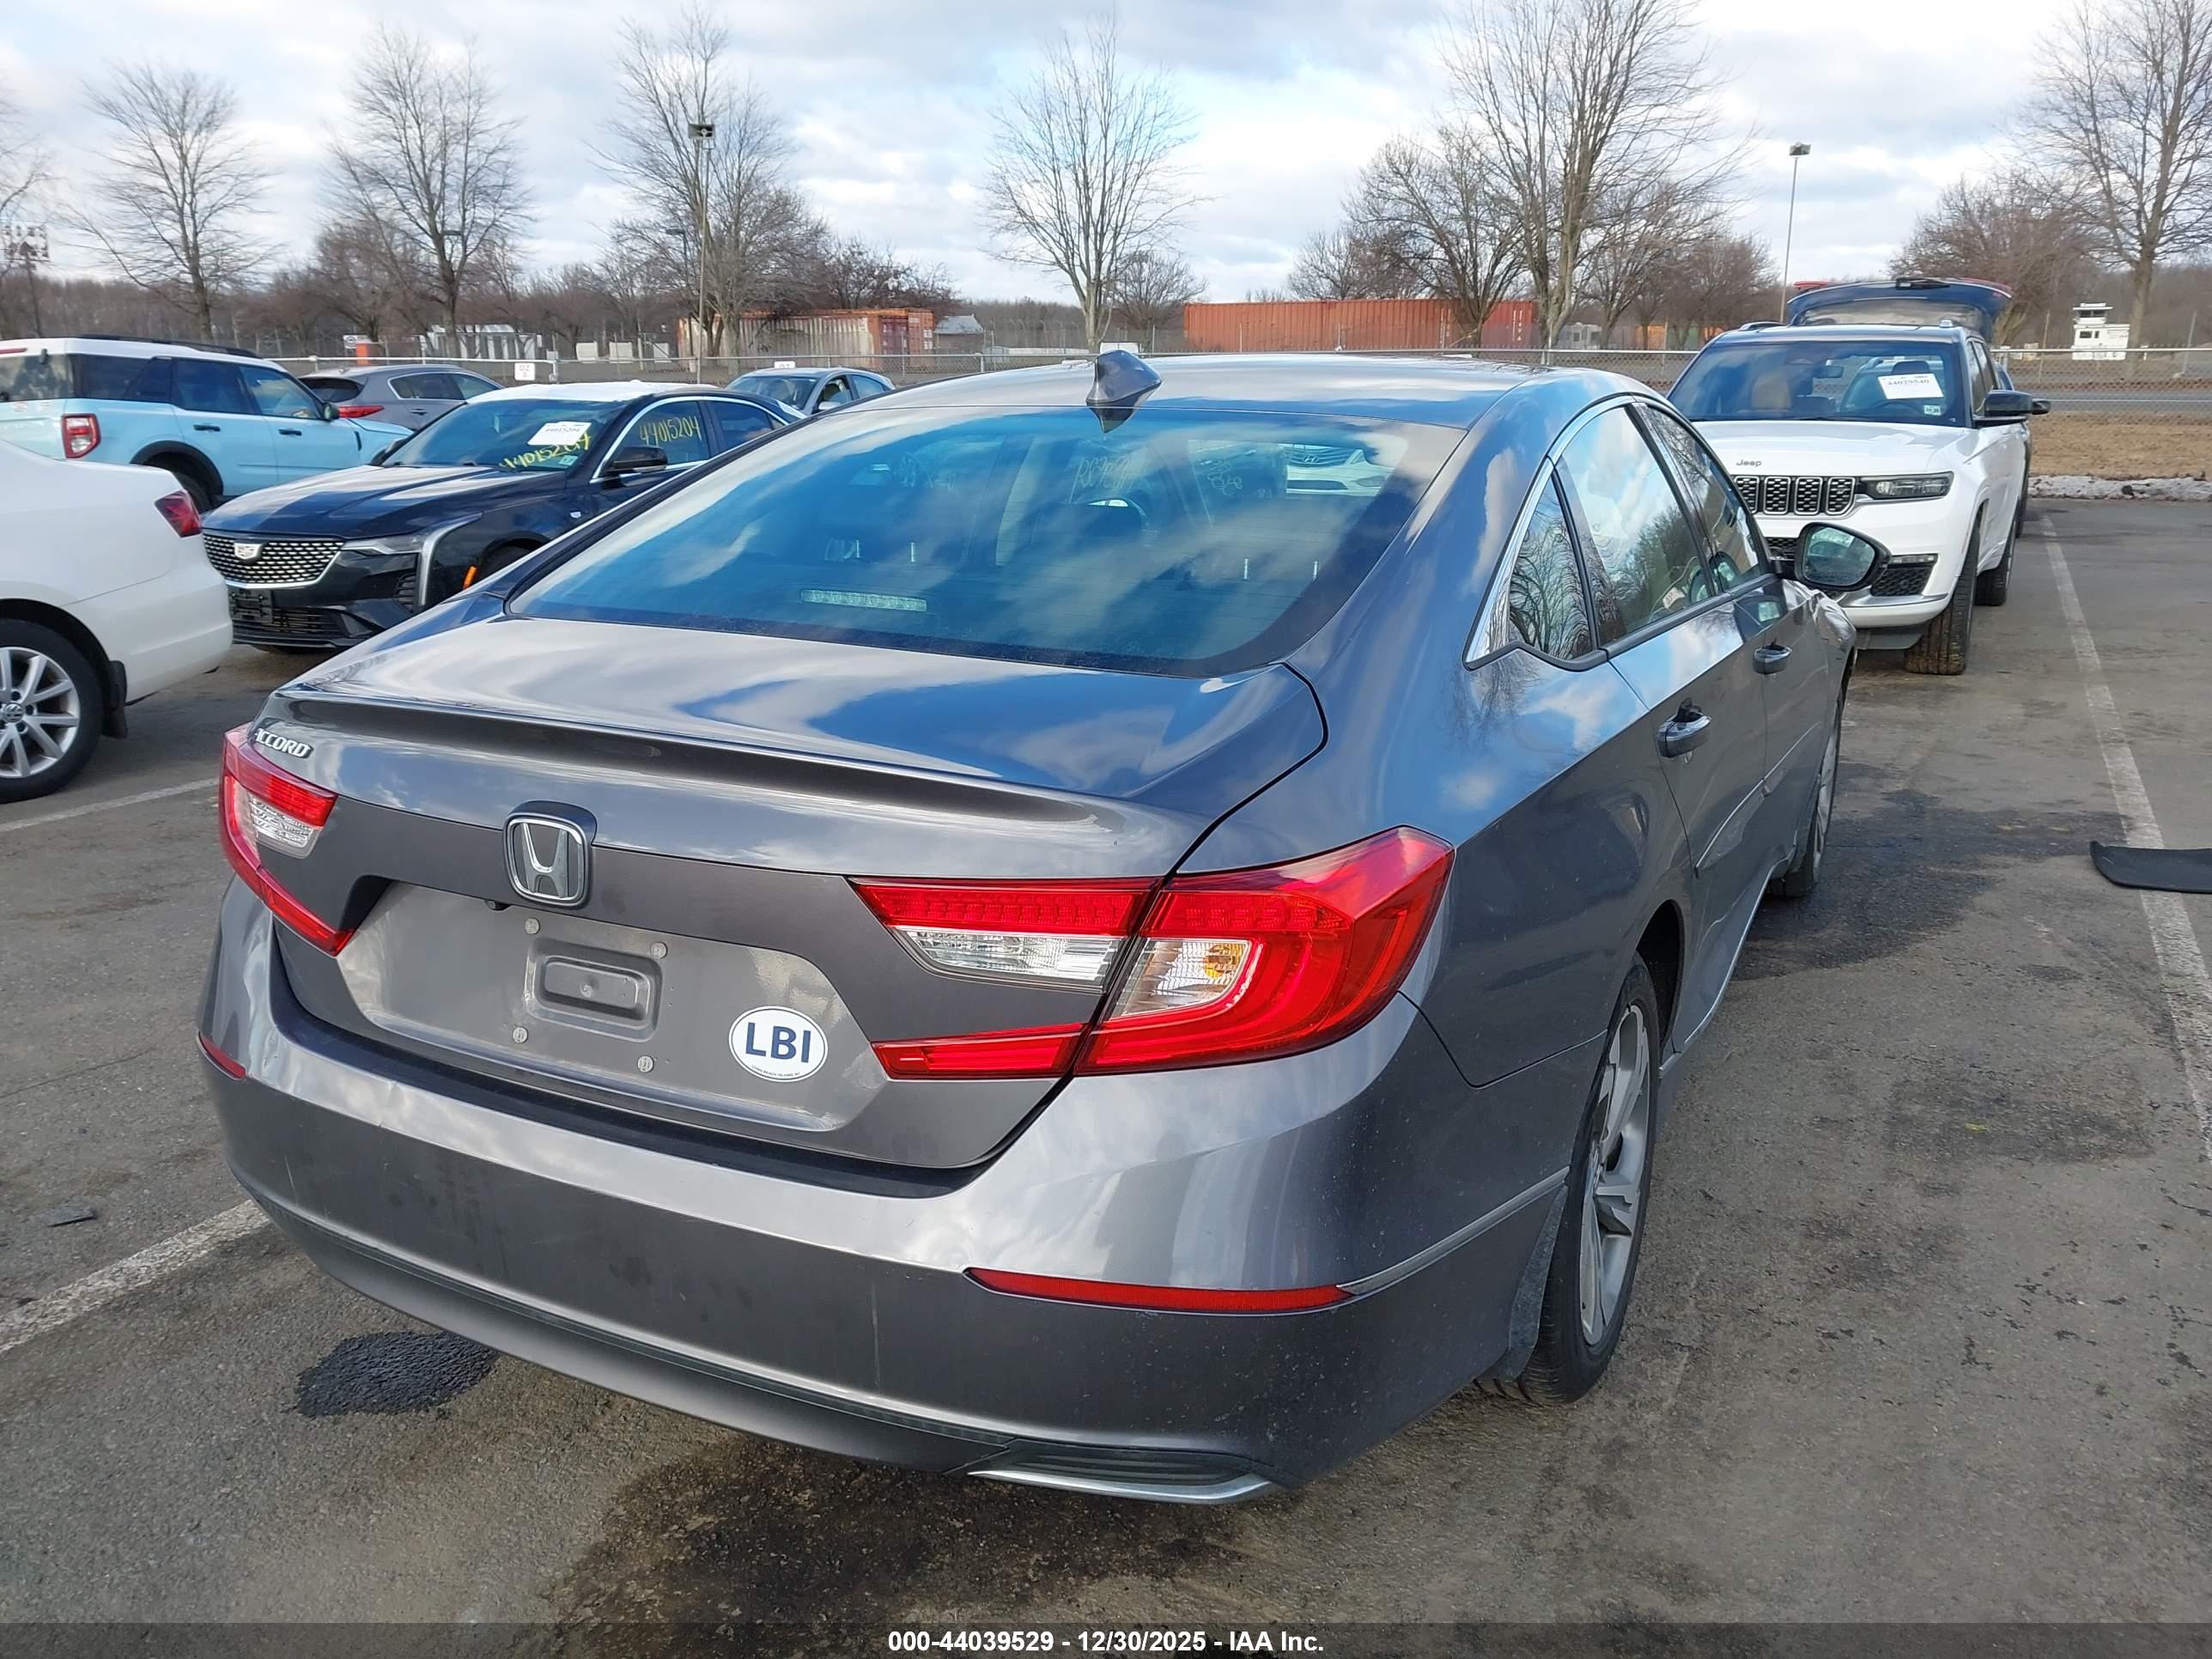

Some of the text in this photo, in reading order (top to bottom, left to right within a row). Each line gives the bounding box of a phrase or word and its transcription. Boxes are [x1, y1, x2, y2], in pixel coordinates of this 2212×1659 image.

[640, 416, 702, 447] 44015204
[1735, 459, 1763, 468] Jeep
[745, 1022, 811, 1063] LBI
